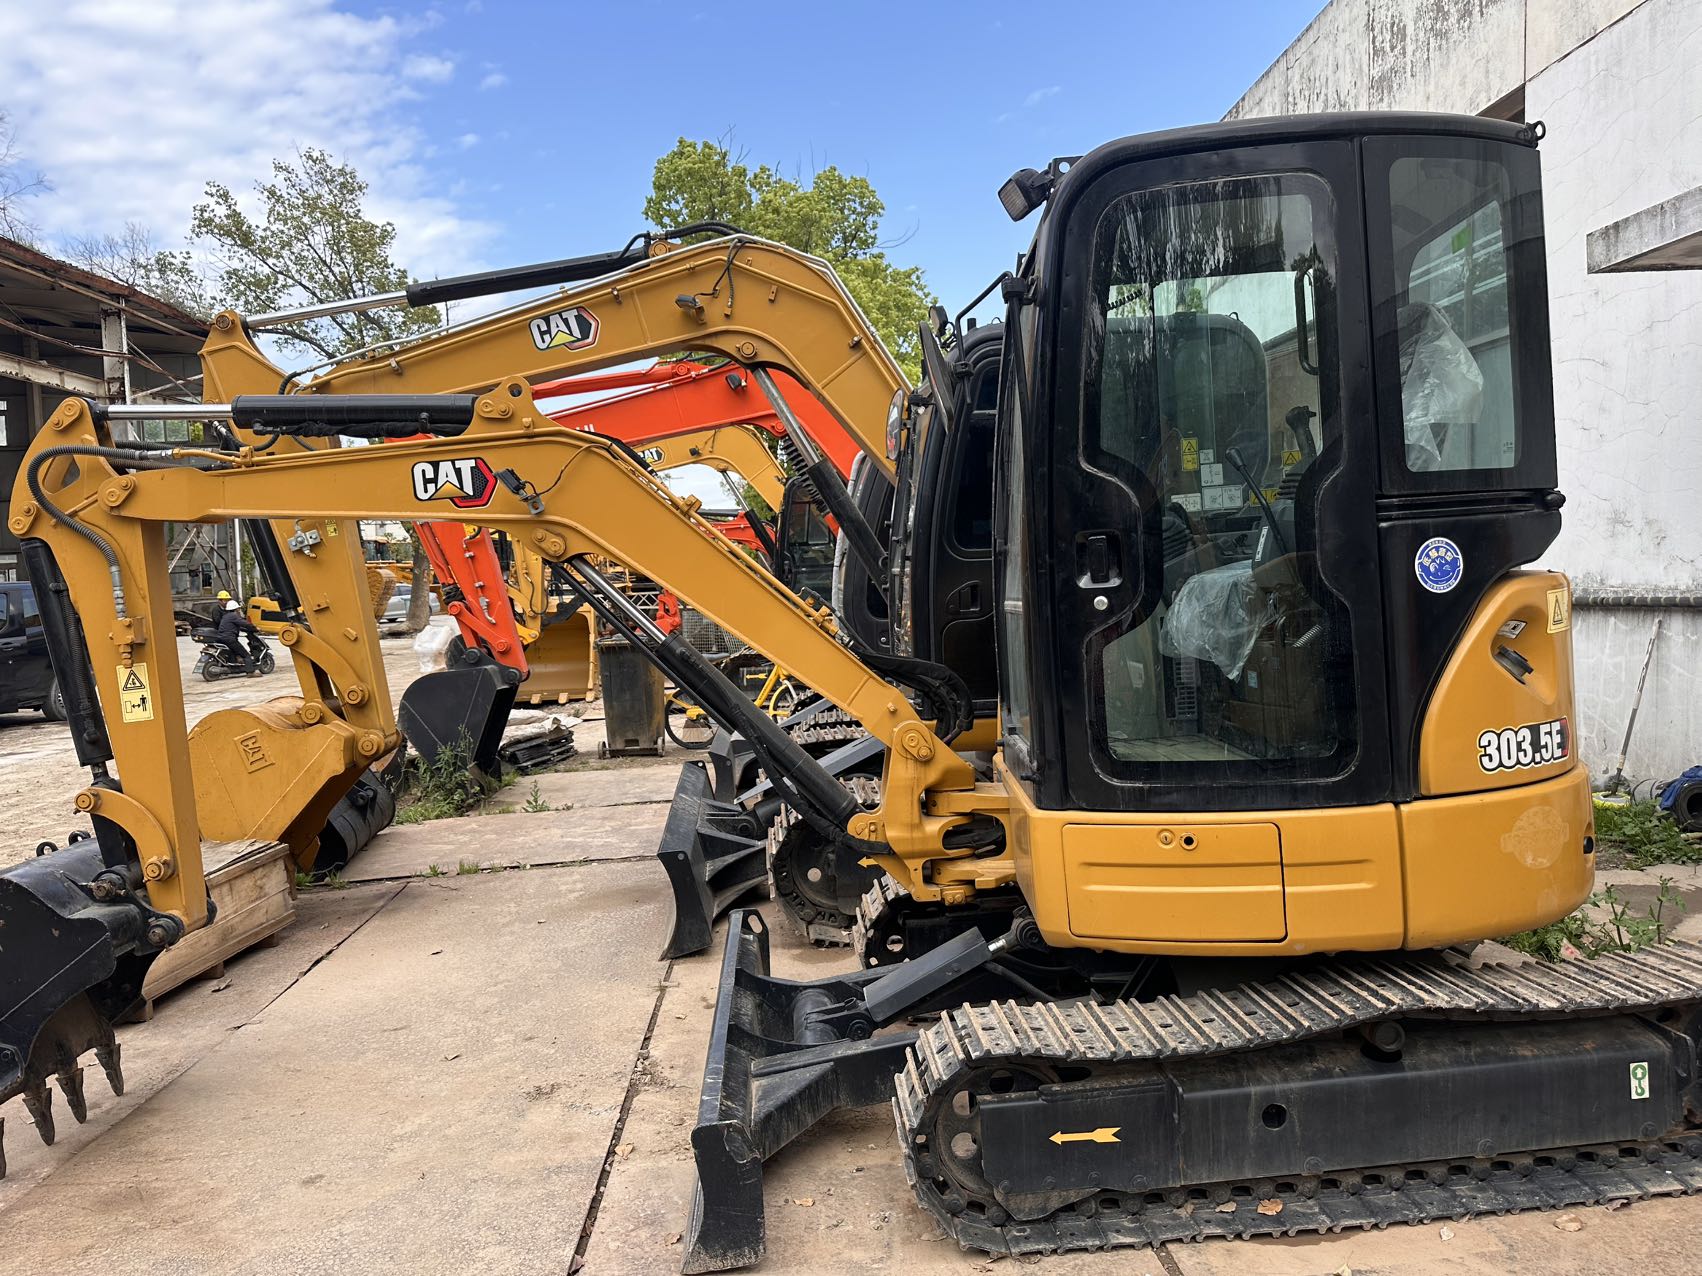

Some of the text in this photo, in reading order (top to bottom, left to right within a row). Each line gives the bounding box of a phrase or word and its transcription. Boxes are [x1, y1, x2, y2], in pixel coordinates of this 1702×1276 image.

[530, 308, 582, 350] CAT
[413, 458, 476, 501] CAT
[240, 735, 267, 766] CAT
[1479, 720, 1563, 770] 303.5E
